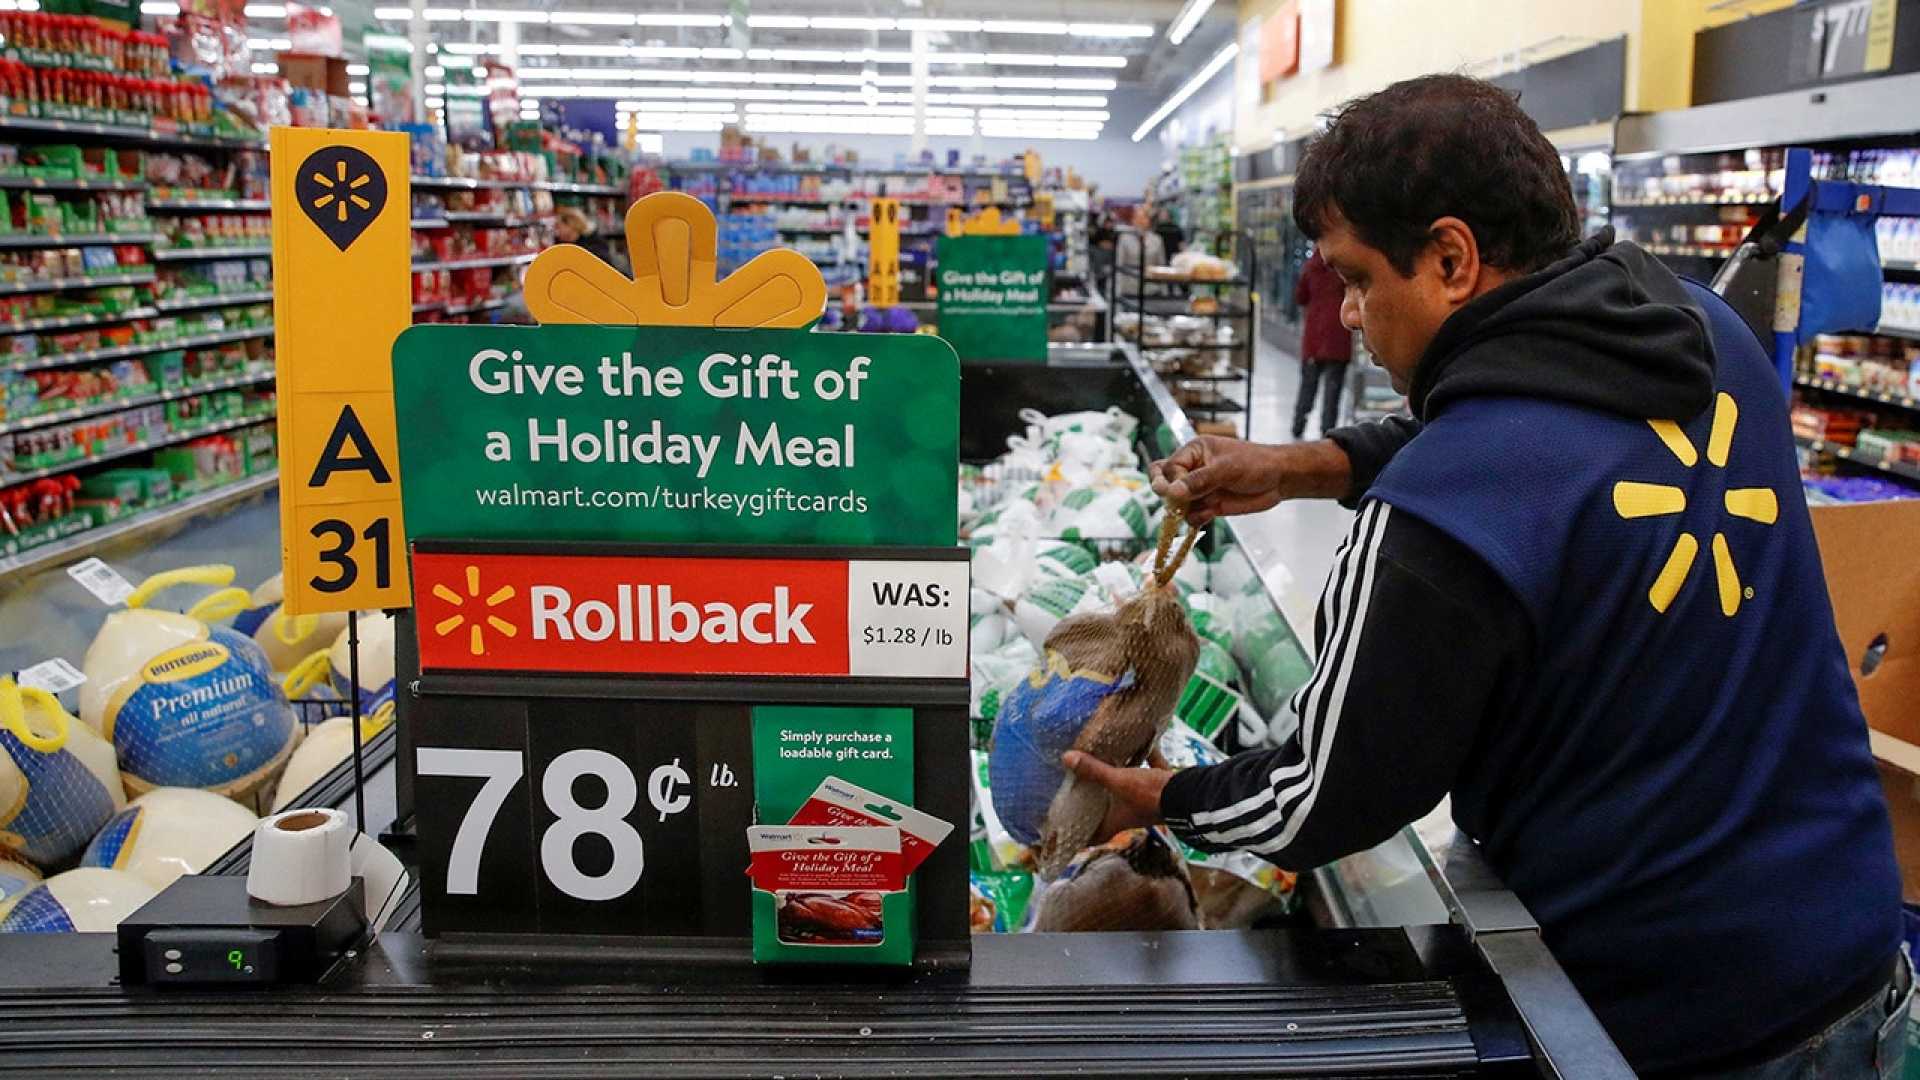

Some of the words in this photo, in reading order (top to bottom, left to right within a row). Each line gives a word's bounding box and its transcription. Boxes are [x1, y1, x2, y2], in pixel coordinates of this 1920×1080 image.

[943, 270, 974, 285] Give
[976, 271, 998, 285] the
[1000, 270, 1027, 285] Gift
[1029, 270, 1045, 285] of
[954, 288, 1005, 306] Holiday
[1006, 289, 1039, 303] Meal
[469, 349, 585, 396] Give
[597, 352, 684, 397] the
[699, 353, 800, 399] Gift
[814, 356, 872, 400] of
[308, 404, 393, 487] A
[484, 431, 511, 461] a
[528, 418, 721, 478] Holiday
[735, 421, 854, 468] Meal
[475, 482, 868, 517] walmart.com/turkeygiftcards
[309, 517, 391, 593] 31
[872, 581, 950, 608] WAS:
[530, 584, 816, 645] Rollback
[863, 625, 916, 646] $1.28
[936, 628, 952, 646] lb
[151, 673, 254, 721] Premium
[780, 729, 823, 745] Simply
[825, 730, 883, 745] purchase
[884, 734, 893, 743] a
[780, 747, 833, 759] loadable
[836, 747, 859, 762] gift
[861, 747, 894, 759] card.
[710, 763, 739, 787] lb.
[760, 832, 793, 841] Walmart
[780, 851, 810, 862] Give
[812, 852, 831, 862] the
[833, 852, 859, 862] Gift
[860, 852, 875, 865] of
[792, 862, 840, 875] Holiday
[842, 861, 875, 873] Meal
[228, 950, 243, 970] 9
